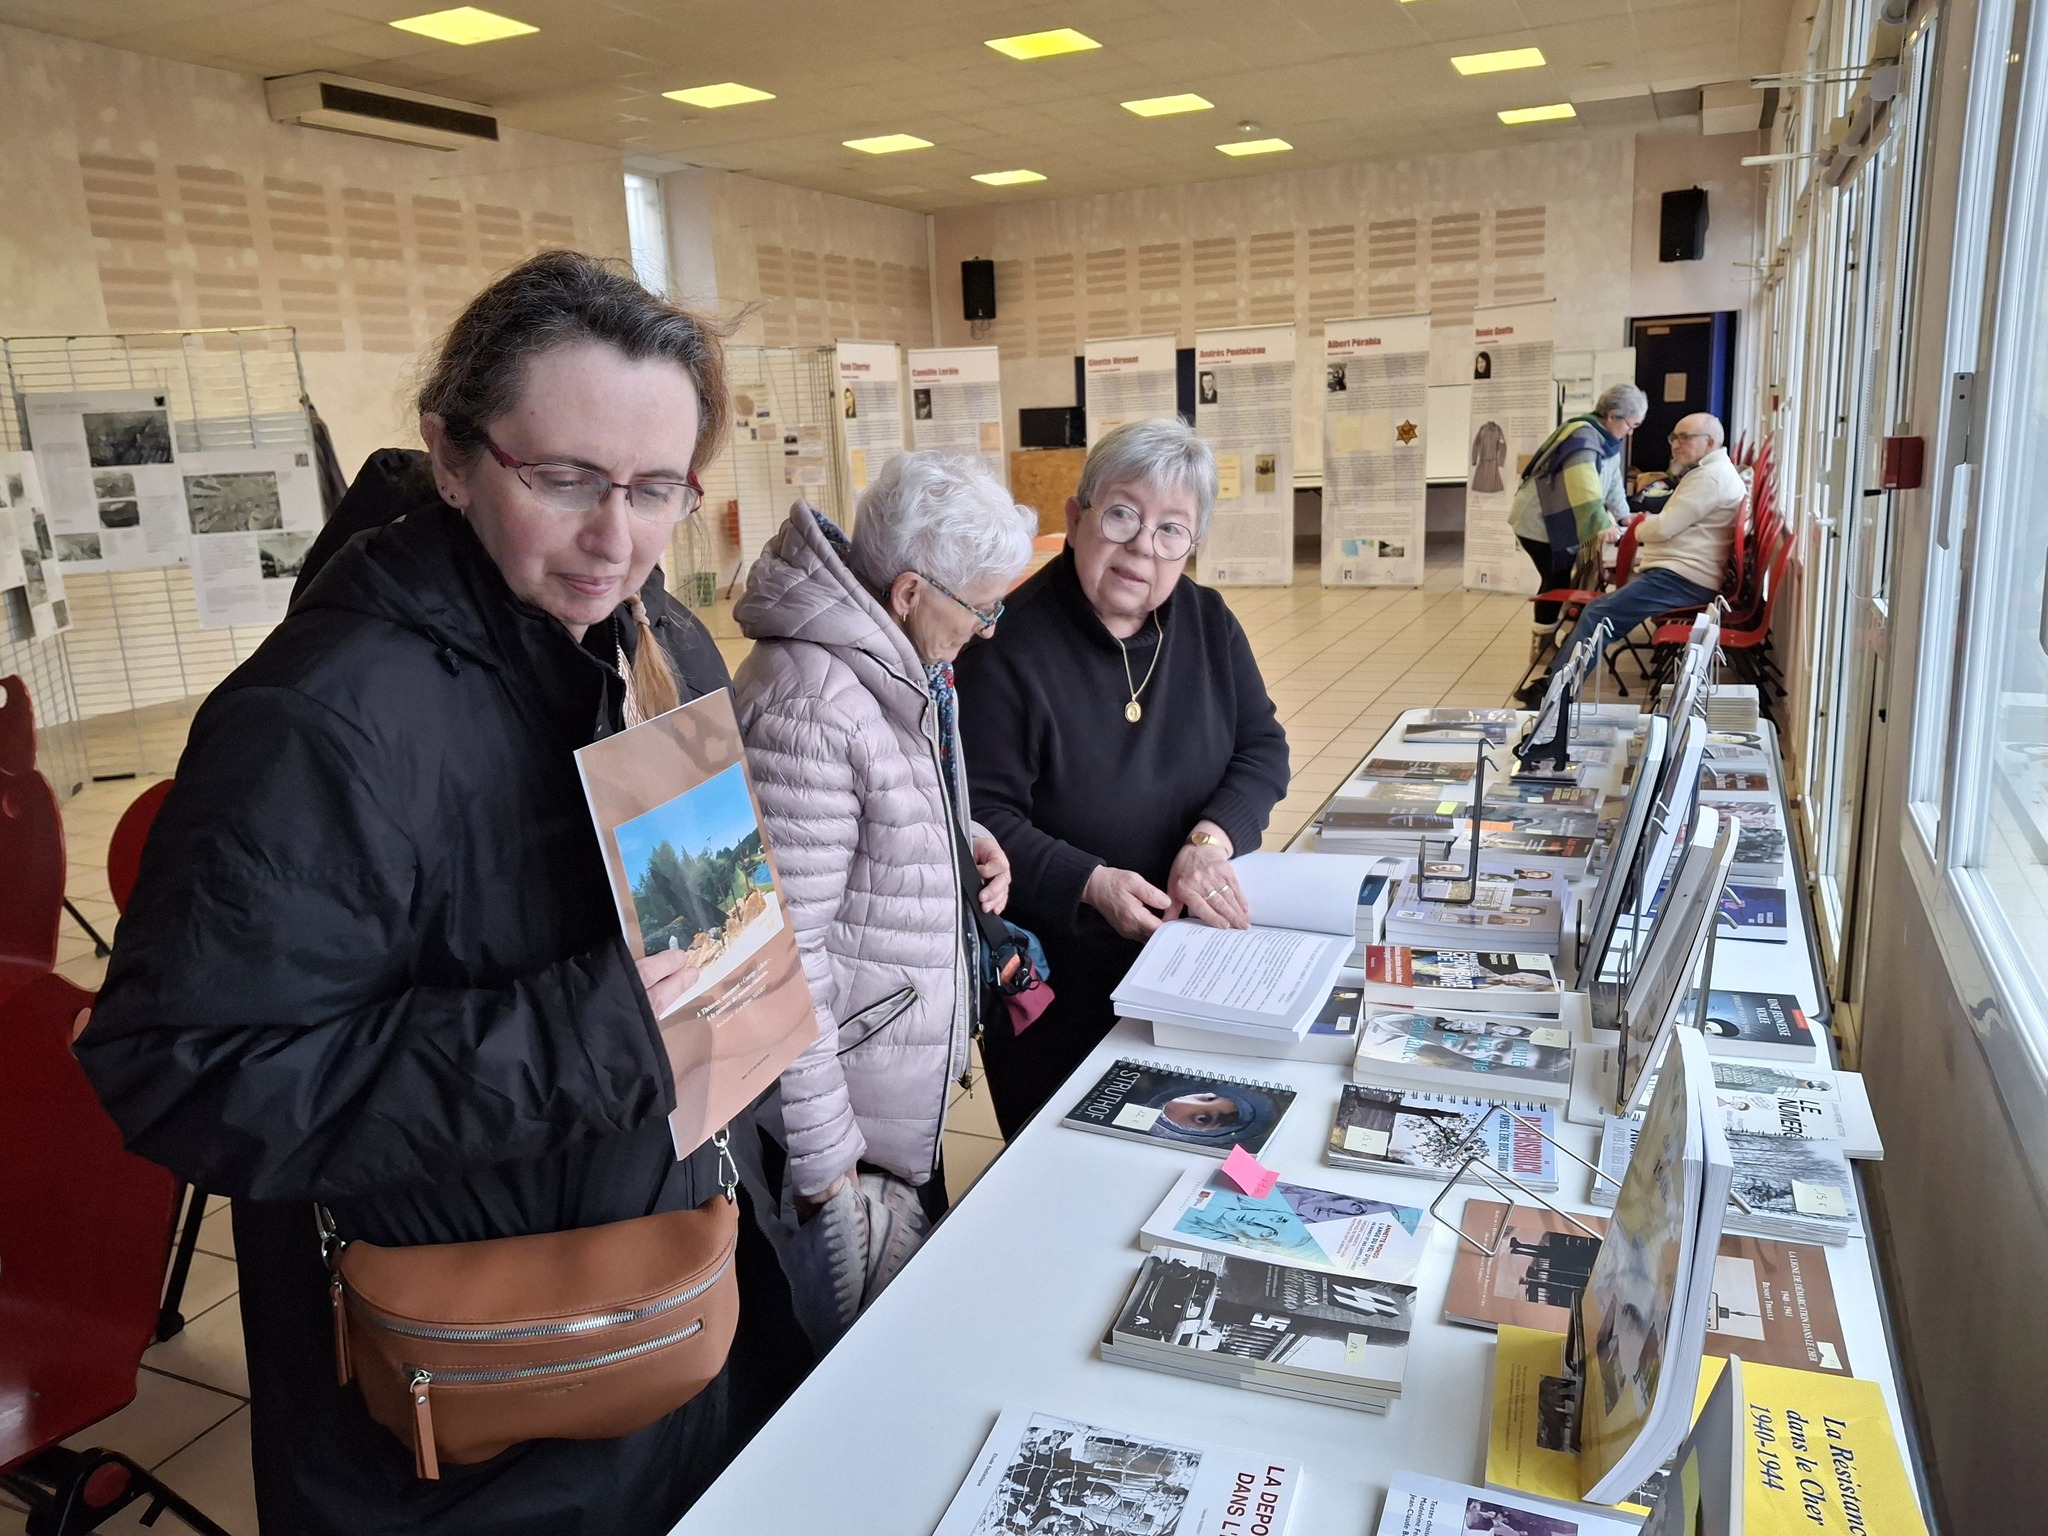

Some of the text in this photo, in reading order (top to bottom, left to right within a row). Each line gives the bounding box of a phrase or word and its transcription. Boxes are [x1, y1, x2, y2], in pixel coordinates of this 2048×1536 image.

[1436, 951, 1455, 988] DE LAUWE
[1452, 951, 1473, 989] CHOMBART
[1756, 1007, 1772, 1024] VOLÉE
[1767, 998, 1791, 1037] UNE JEUNESSE
[1442, 1033, 1461, 1047] de
[1084, 1069, 1140, 1120] STRUTHOF
[1800, 1100, 1822, 1115] LE
[1499, 1114, 1513, 1129] APRÈS
[1499, 1143, 1509, 1151] DES
[1513, 1116, 1549, 1174] RAVENSBRÜCK
[1814, 1188, 1828, 1200] 15
[1378, 1224, 1391, 1243] ANNETTE
[1788, 1250, 1818, 1362] LA LIGNE DE DÉMARCATION DANS LE CHER
[1823, 1416, 1846, 1440] La
[1750, 1402, 1786, 1492] 1940-1944
[1263, 1465, 1285, 1486] LA
[1786, 1409, 1827, 1526] dans le Cher
[1226, 1472, 1255, 1517] DANS
[1428, 1500, 1438, 1519] Textes
[1403, 1493, 1418, 1529] Jean-Claude
[1415, 1496, 1428, 1527] Madeleine
